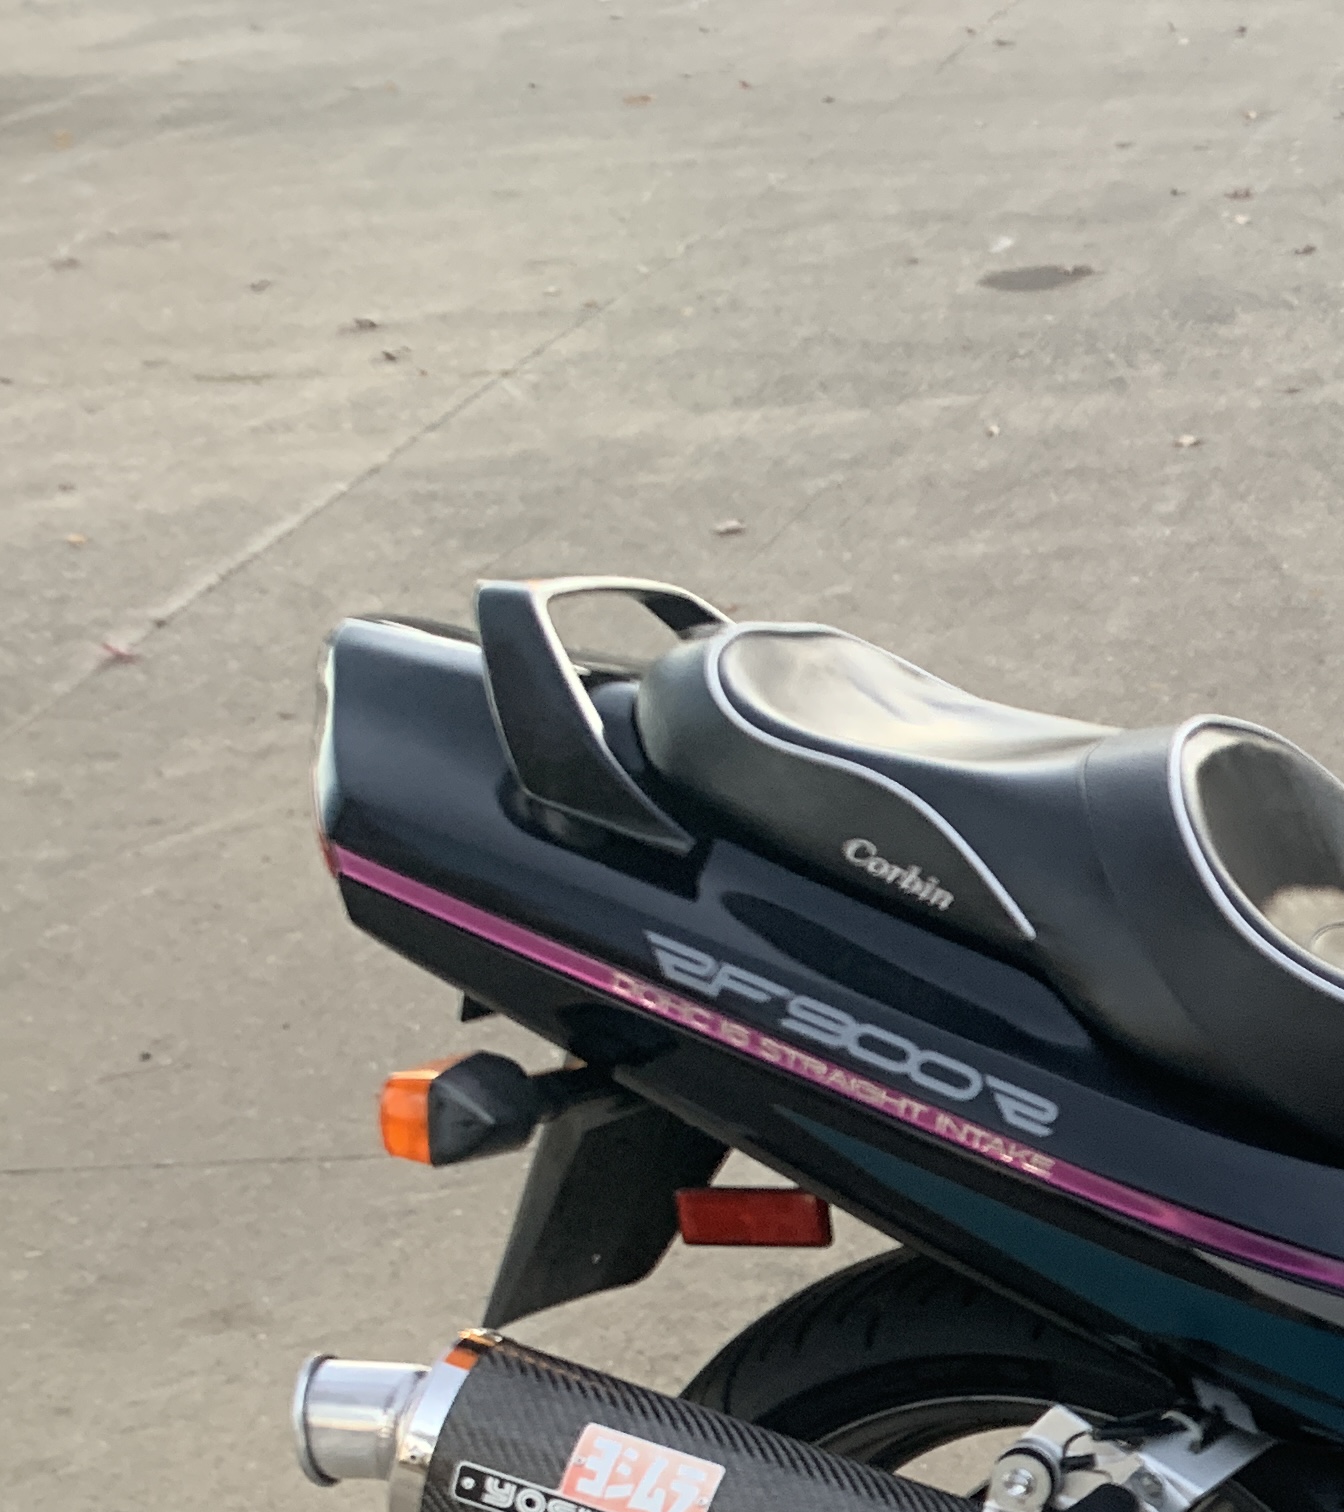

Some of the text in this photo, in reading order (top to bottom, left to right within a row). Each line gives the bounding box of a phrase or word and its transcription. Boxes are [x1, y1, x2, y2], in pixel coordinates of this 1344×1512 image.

[842, 837, 955, 911] Corbin
[612, 973, 712, 1030] DOHC
[761, 1037, 928, 1119] STRAIGHT
[934, 1113, 1056, 1177] INTAKE
